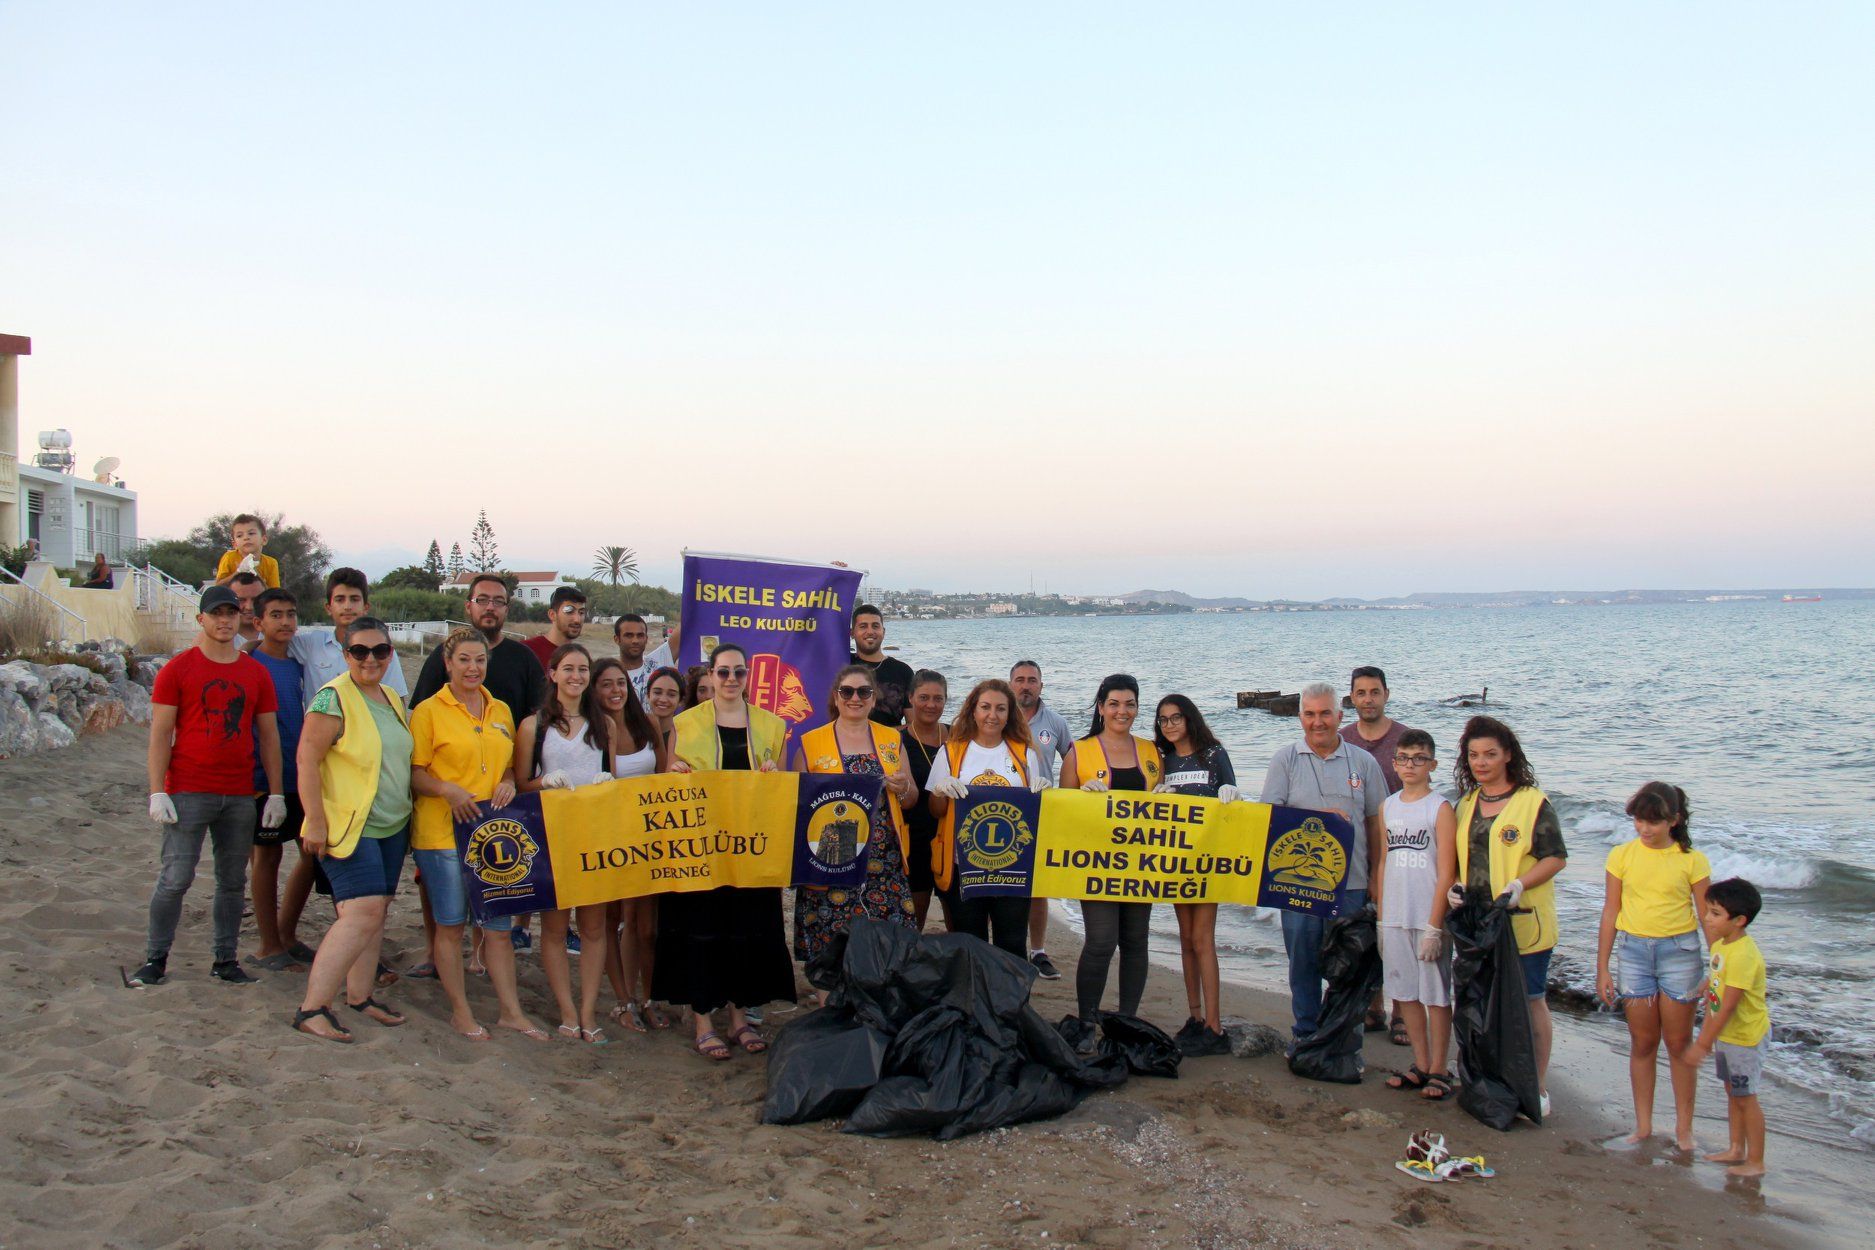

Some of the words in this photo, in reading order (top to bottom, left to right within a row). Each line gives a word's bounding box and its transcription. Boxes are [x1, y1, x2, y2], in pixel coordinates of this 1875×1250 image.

[696, 579, 776, 607] İSKELE
[782, 586, 842, 612] SAHİL
[720, 615, 752, 629] LEO
[756, 617, 817, 632] KULÜBÜ
[638, 786, 708, 806] MAĞUSA
[810, 790, 846, 810] MAĞUSA
[852, 792, 872, 810] KALE
[642, 806, 706, 832] KALE
[974, 802, 1019, 819] LIONS
[1106, 796, 1205, 824] İSKELE
[479, 822, 519, 840] LIONS
[985, 822, 1005, 847] L
[1110, 826, 1193, 850] SAHİL
[492, 841, 514, 864] L
[971, 854, 1014, 866] INTERNATIONAL
[650, 863, 711, 880] DERNEĞ
[808, 858, 827, 872] LIONS
[1046, 849, 1129, 870] LIONS
[1138, 854, 1252, 876] KULÜBÜ
[484, 867, 526, 882] INTERNATIONAL
[987, 874, 1026, 885] Ediyoruz
[1086, 876, 1208, 898] DERNEĞİ
[1268, 884, 1296, 894] LIONS
[1299, 888, 1336, 902] KULÜBÜ
[1288, 898, 1312, 908] 2012
